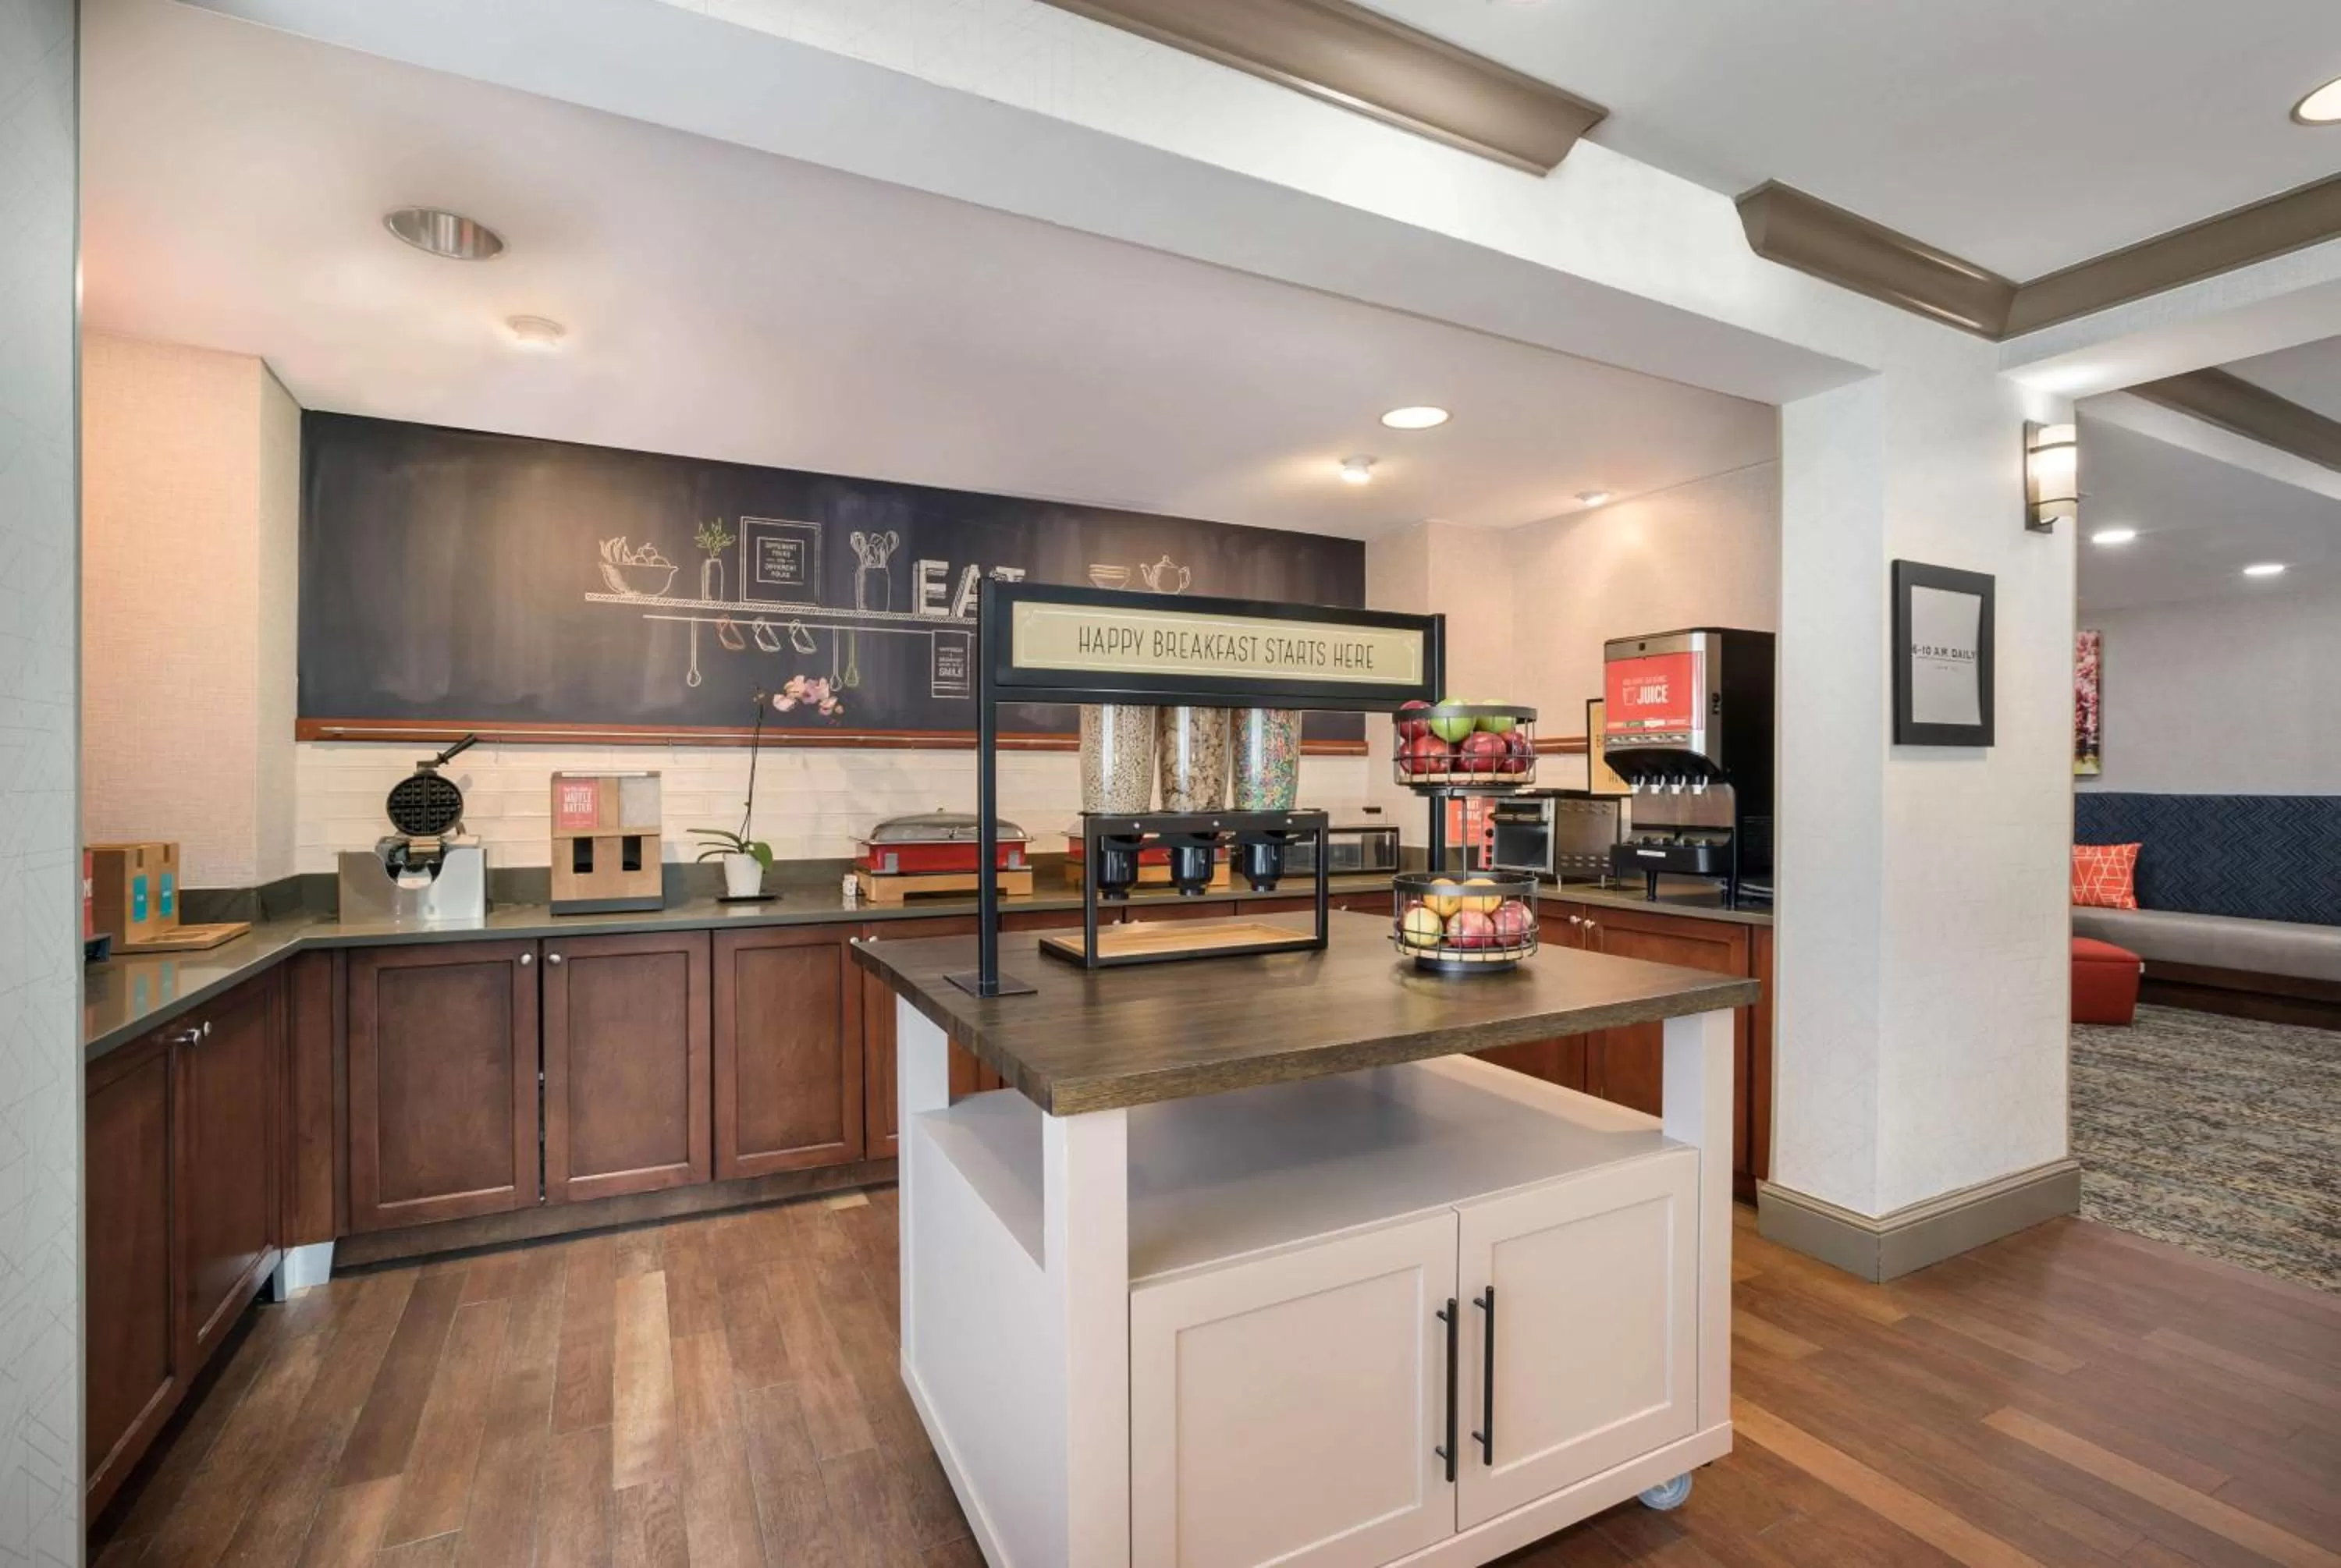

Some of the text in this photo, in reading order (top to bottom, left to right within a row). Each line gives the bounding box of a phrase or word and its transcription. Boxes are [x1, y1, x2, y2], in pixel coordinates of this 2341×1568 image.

[1079, 626, 1374, 669] HAPPY BREAKFAST STARTS HERE
[1952, 648, 1977, 659] DAILY
[1636, 684, 1669, 705] JUICE
